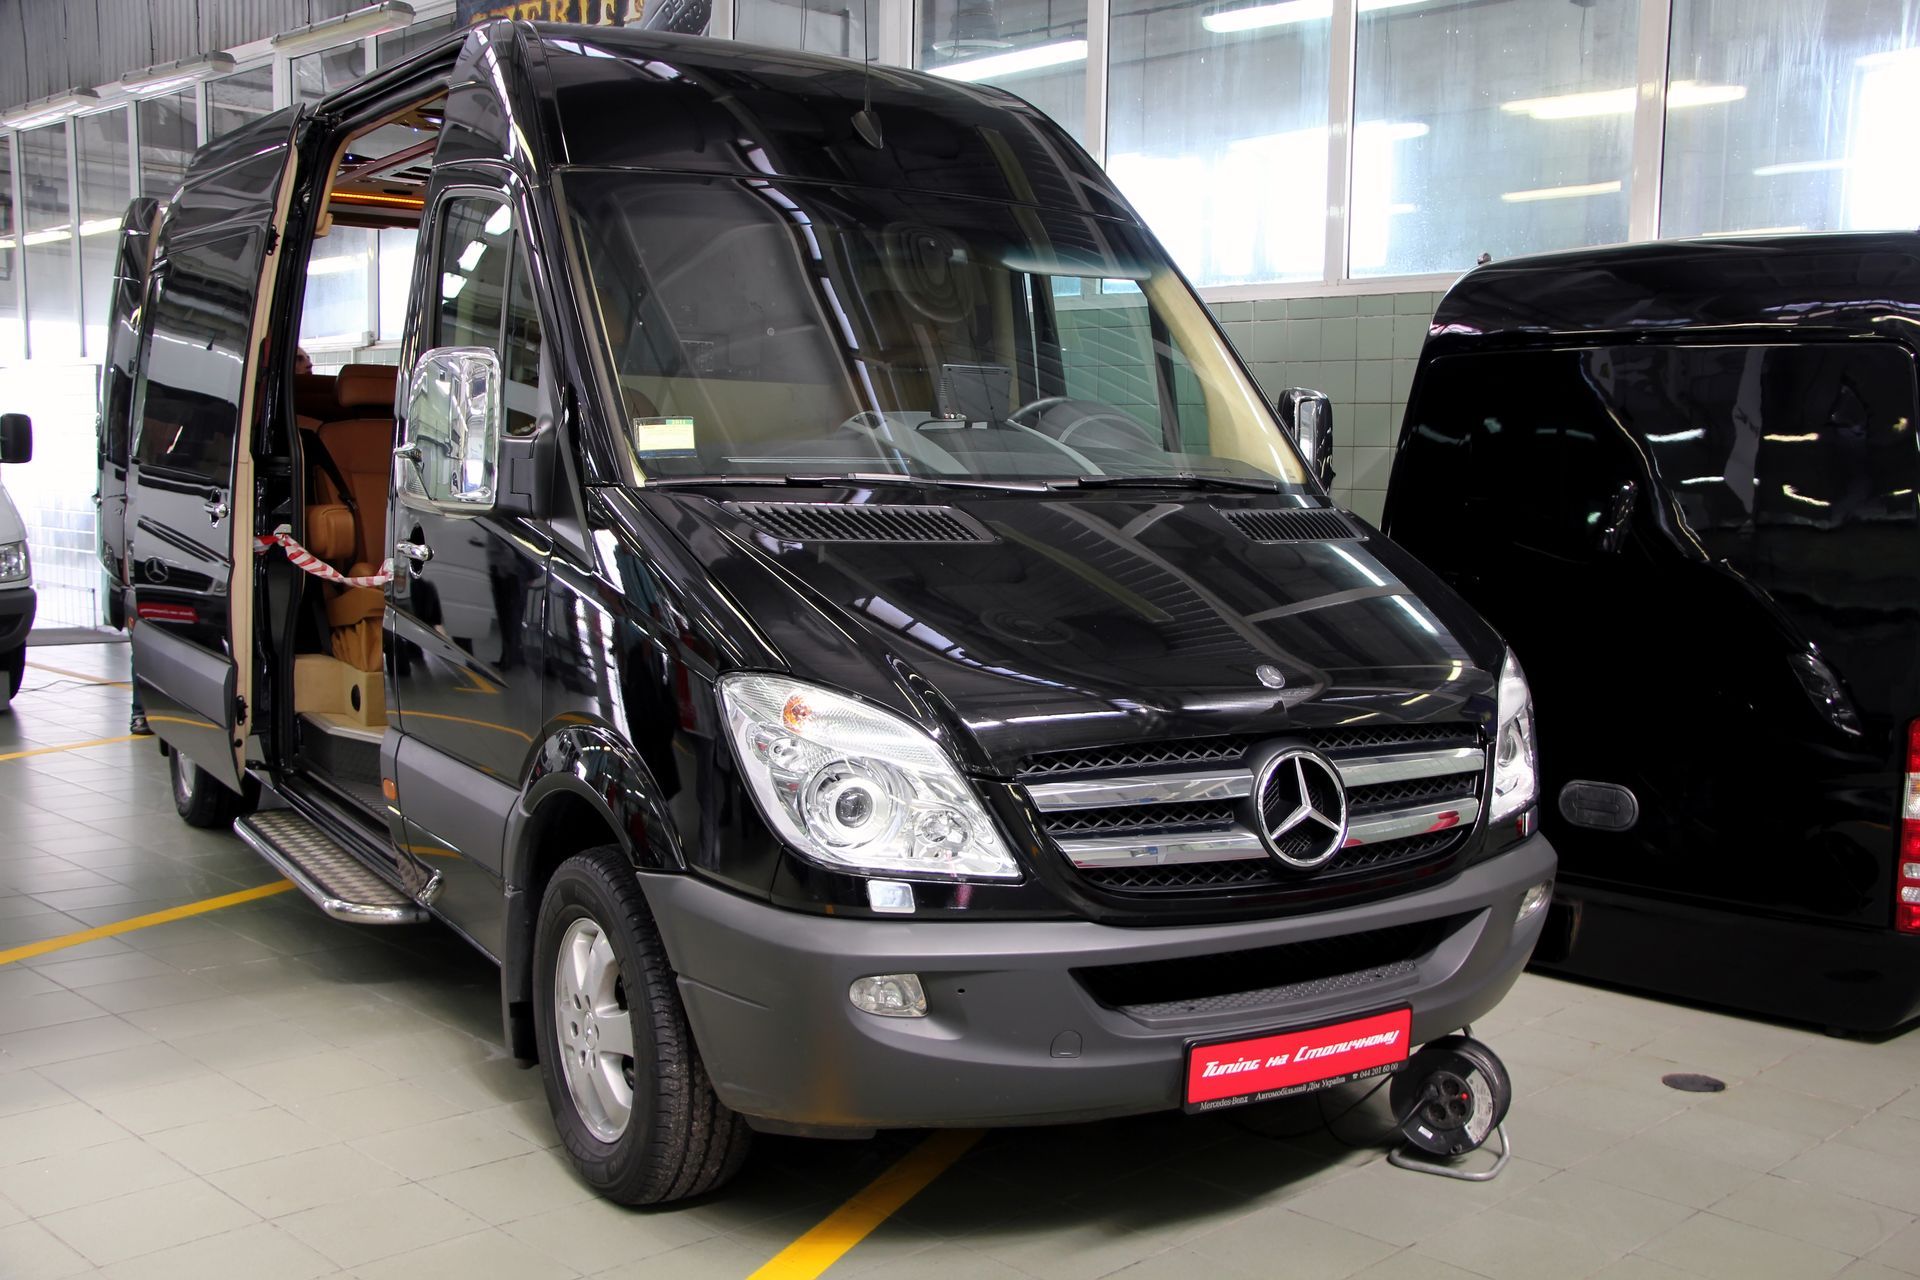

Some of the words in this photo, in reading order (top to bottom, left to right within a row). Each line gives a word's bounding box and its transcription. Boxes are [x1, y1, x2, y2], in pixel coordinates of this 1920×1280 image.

[1265, 1053, 1290, 1068] на
[1293, 1029, 1400, 1063] Столичному
[1199, 1095, 1248, 1111] Mercedes-Benz
[1255, 1082, 1307, 1101] Автомобільний
[1306, 1081, 1320, 1092] Дім
[1359, 1069, 1371, 1079] 044
[1371, 1066, 1382, 1076] 201
[1382, 1064, 1391, 1073] 60
[1391, 1062, 1399, 1071] 00
